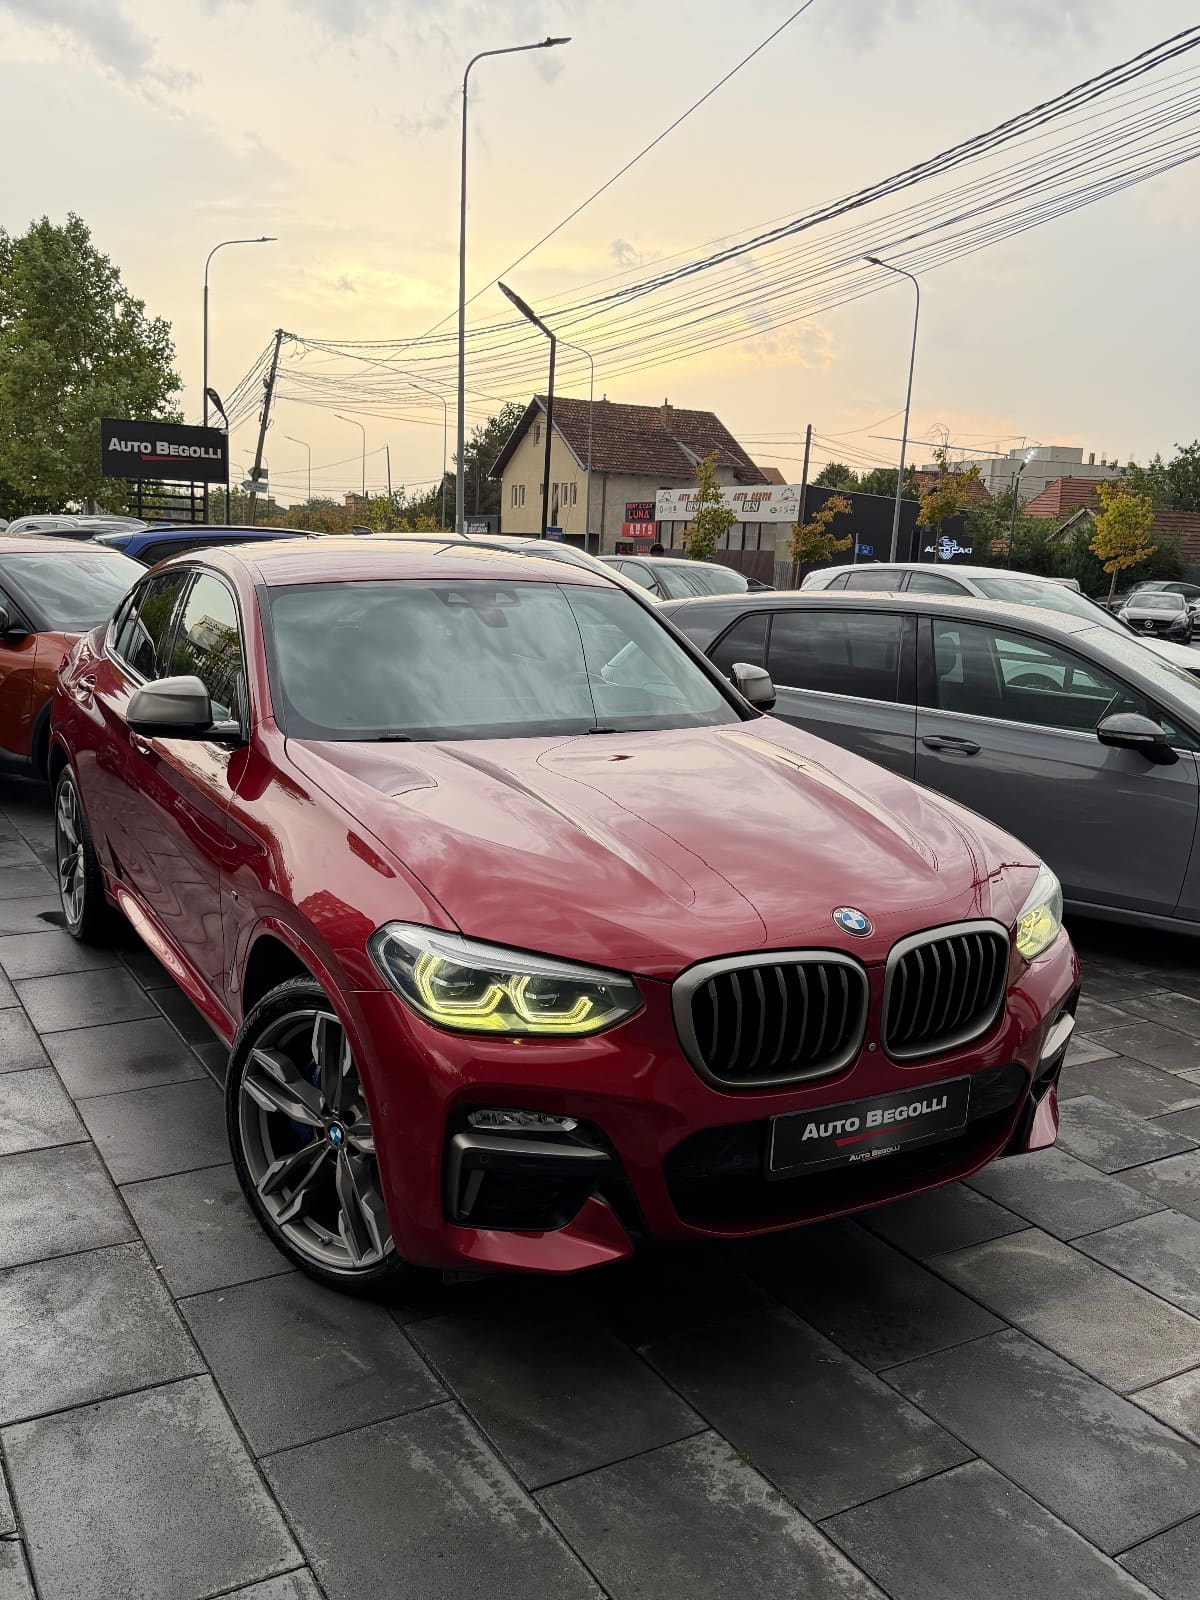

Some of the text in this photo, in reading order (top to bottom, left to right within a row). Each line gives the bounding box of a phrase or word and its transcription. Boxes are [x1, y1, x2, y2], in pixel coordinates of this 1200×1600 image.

[108, 438, 222, 459] AUTO BEGOLLI
[733, 493, 748, 501] AUTO
[628, 510, 650, 519] LUNA
[629, 523, 653, 535] AUTO
[802, 1096, 948, 1141] AUTO BEGOLLI
[849, 1145, 900, 1161] AUTO BEGOLLI
